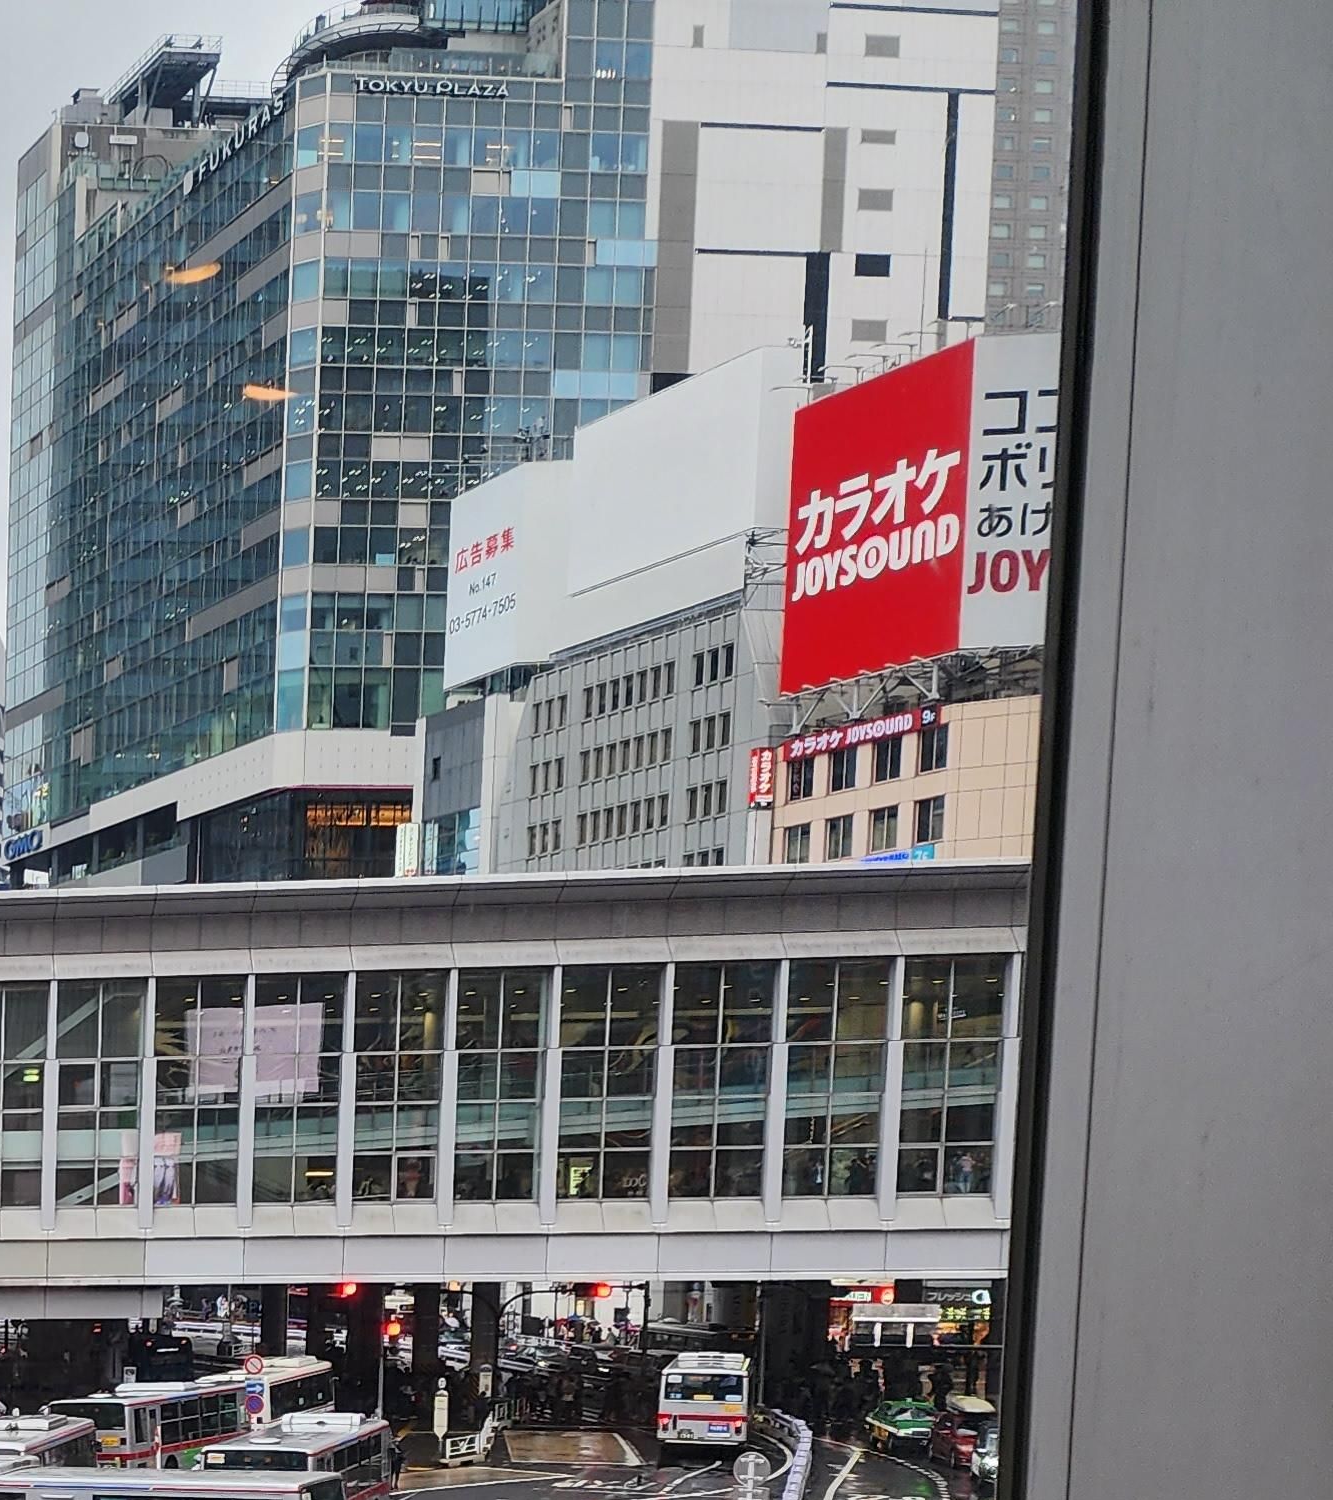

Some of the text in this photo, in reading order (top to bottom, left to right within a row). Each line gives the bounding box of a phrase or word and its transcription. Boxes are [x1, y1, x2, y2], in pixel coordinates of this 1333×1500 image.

[356, 77, 510, 98] TOKYU PLAZA
[198, 93, 284, 183] FUKURAS
[795, 449, 961, 556] カラオケ
[454, 526, 515, 575] 広告募集
[791, 513, 961, 602] JOYSOUND
[468, 572, 497, 596] No.147
[790, 713, 914, 758] カラオケ JOYSOUND
[759, 750, 773, 794] カラオケ
[4, 830, 43, 861] GMO
